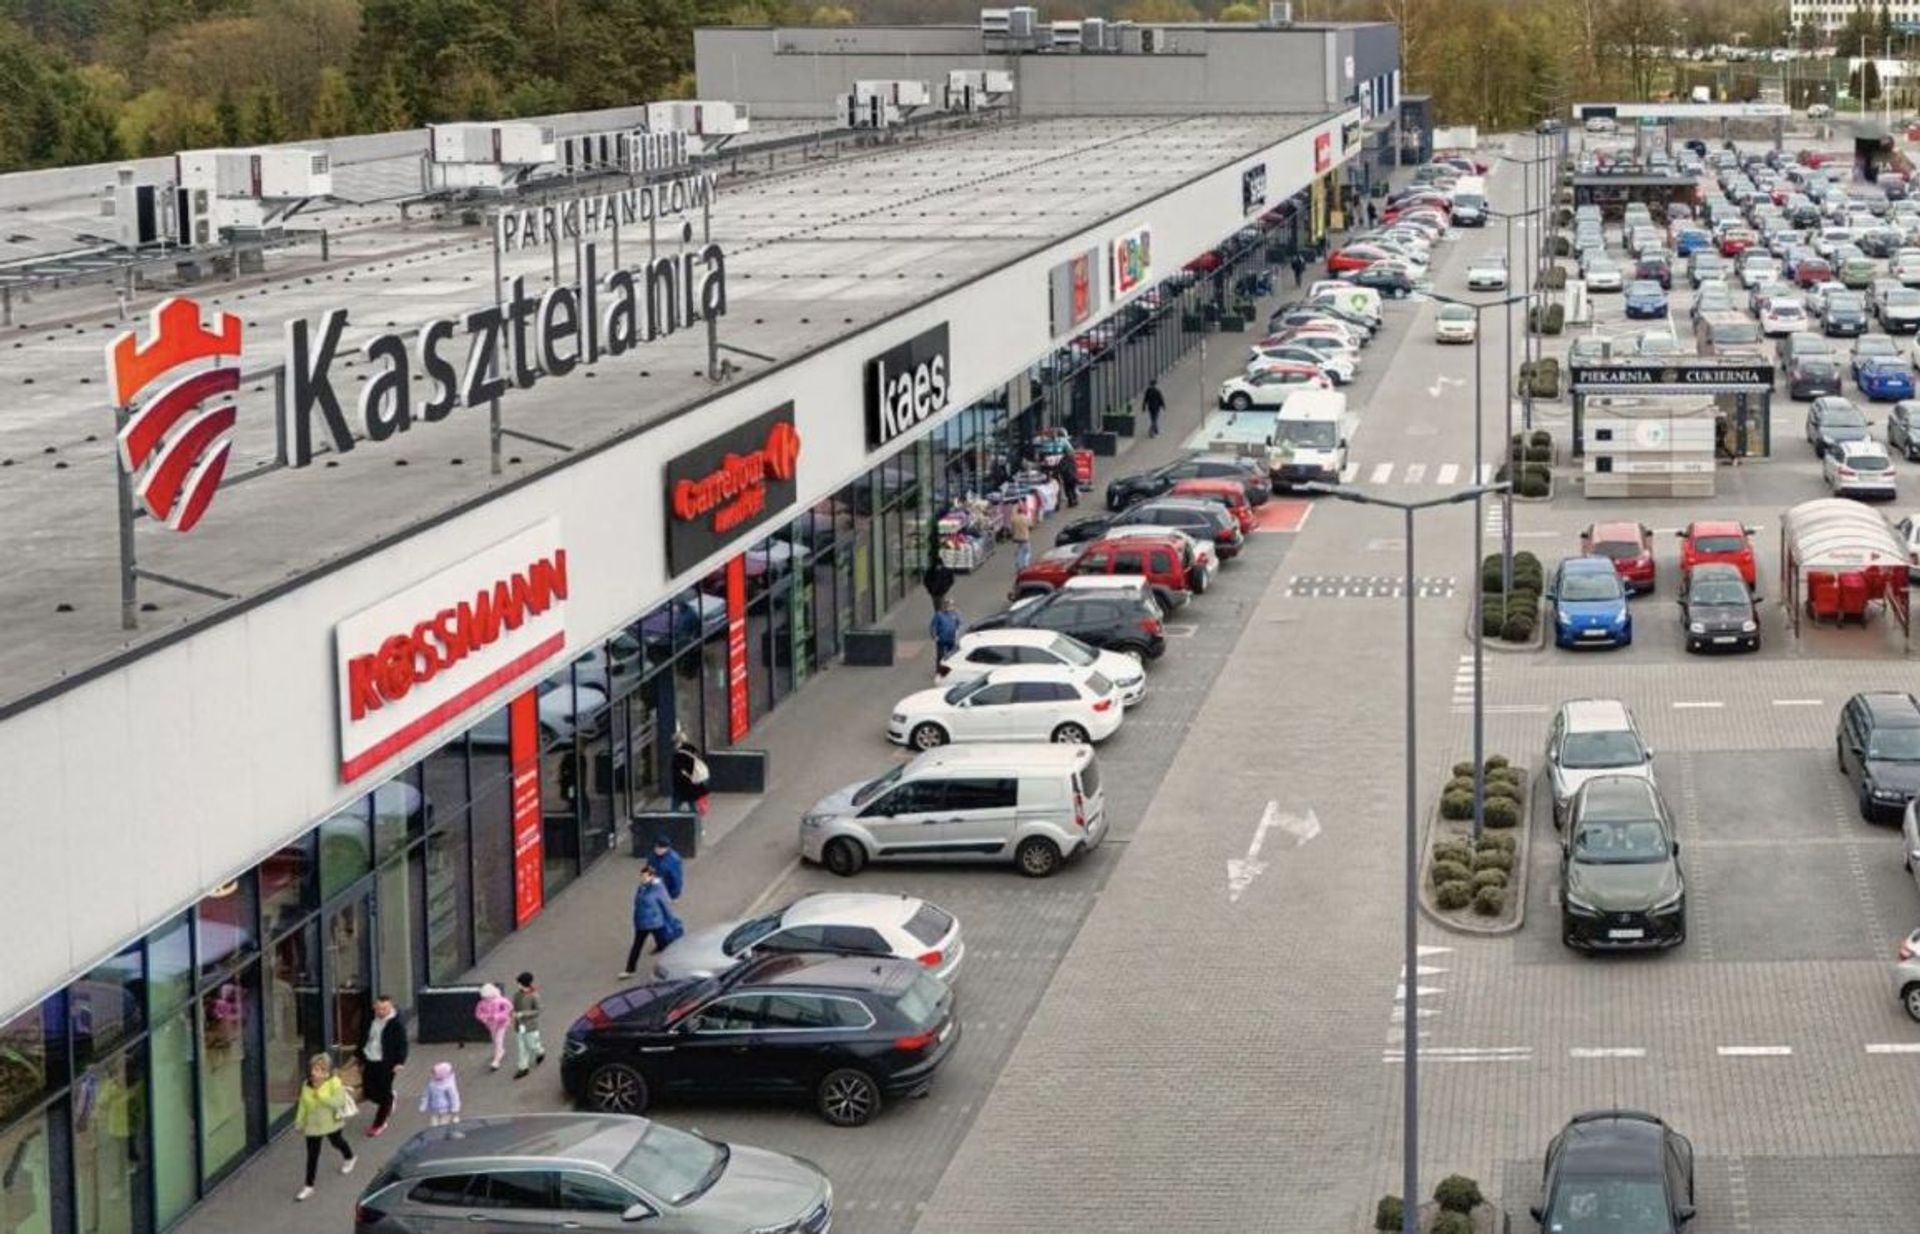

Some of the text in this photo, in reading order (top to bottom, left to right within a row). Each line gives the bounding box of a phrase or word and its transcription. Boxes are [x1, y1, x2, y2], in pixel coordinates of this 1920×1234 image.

[502, 172, 718, 253] PARK HANDLOWY
[285, 222, 728, 468] Kasztelania
[1580, 370, 1760, 383] PIEKARNIA CUKIERNIA
[878, 353, 945, 444] kaes
[674, 452, 765, 521] Carrefour
[348, 549, 568, 721] ROSSMANN
